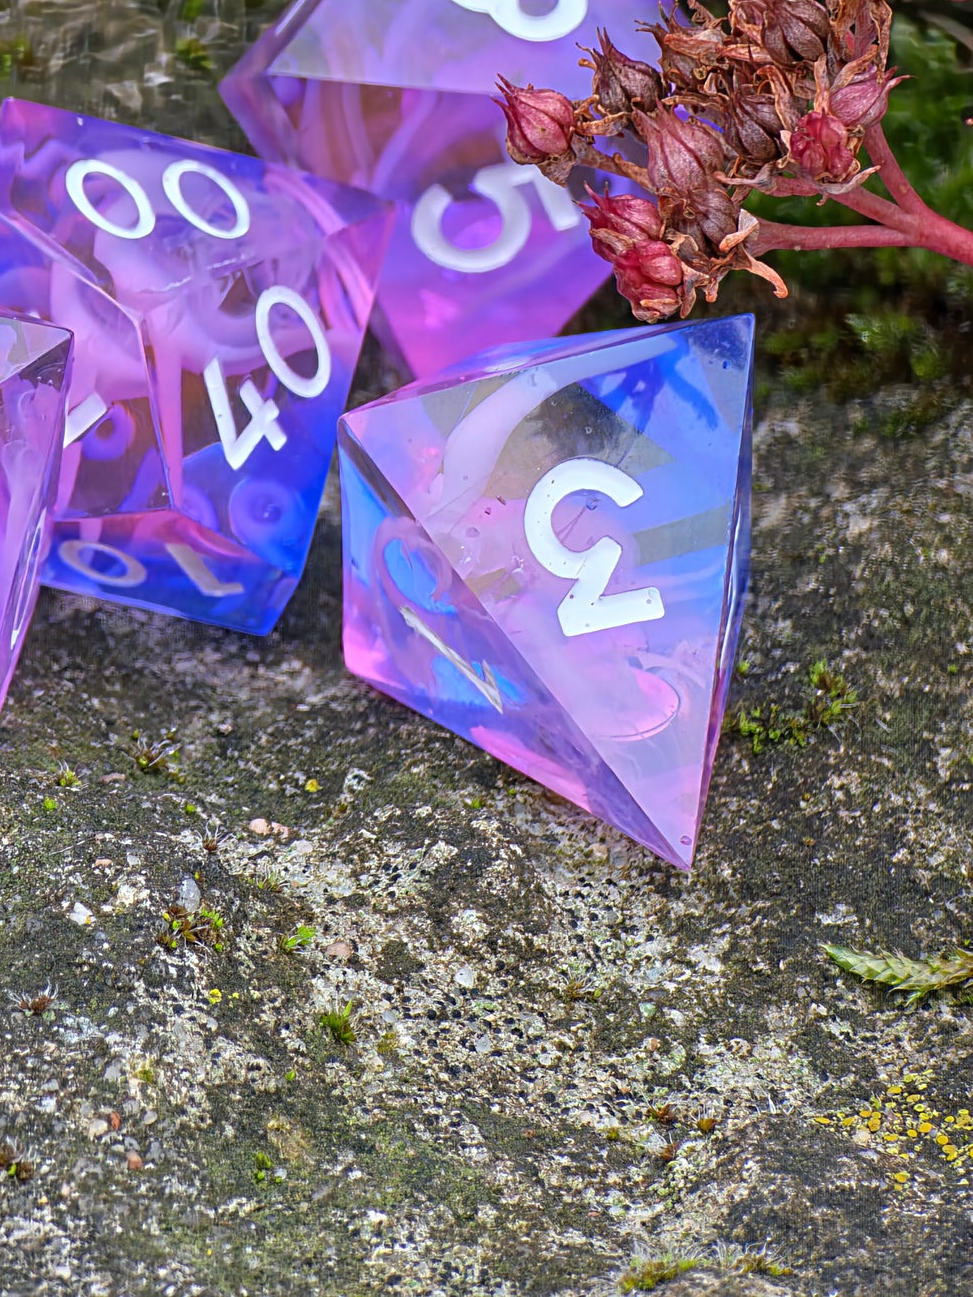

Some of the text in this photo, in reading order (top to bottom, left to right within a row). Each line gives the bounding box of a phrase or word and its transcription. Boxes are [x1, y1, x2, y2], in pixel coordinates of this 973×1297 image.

[65, 159, 250, 239] 00
[411, 164, 580, 274] 5
[203, 285, 331, 471] 40
